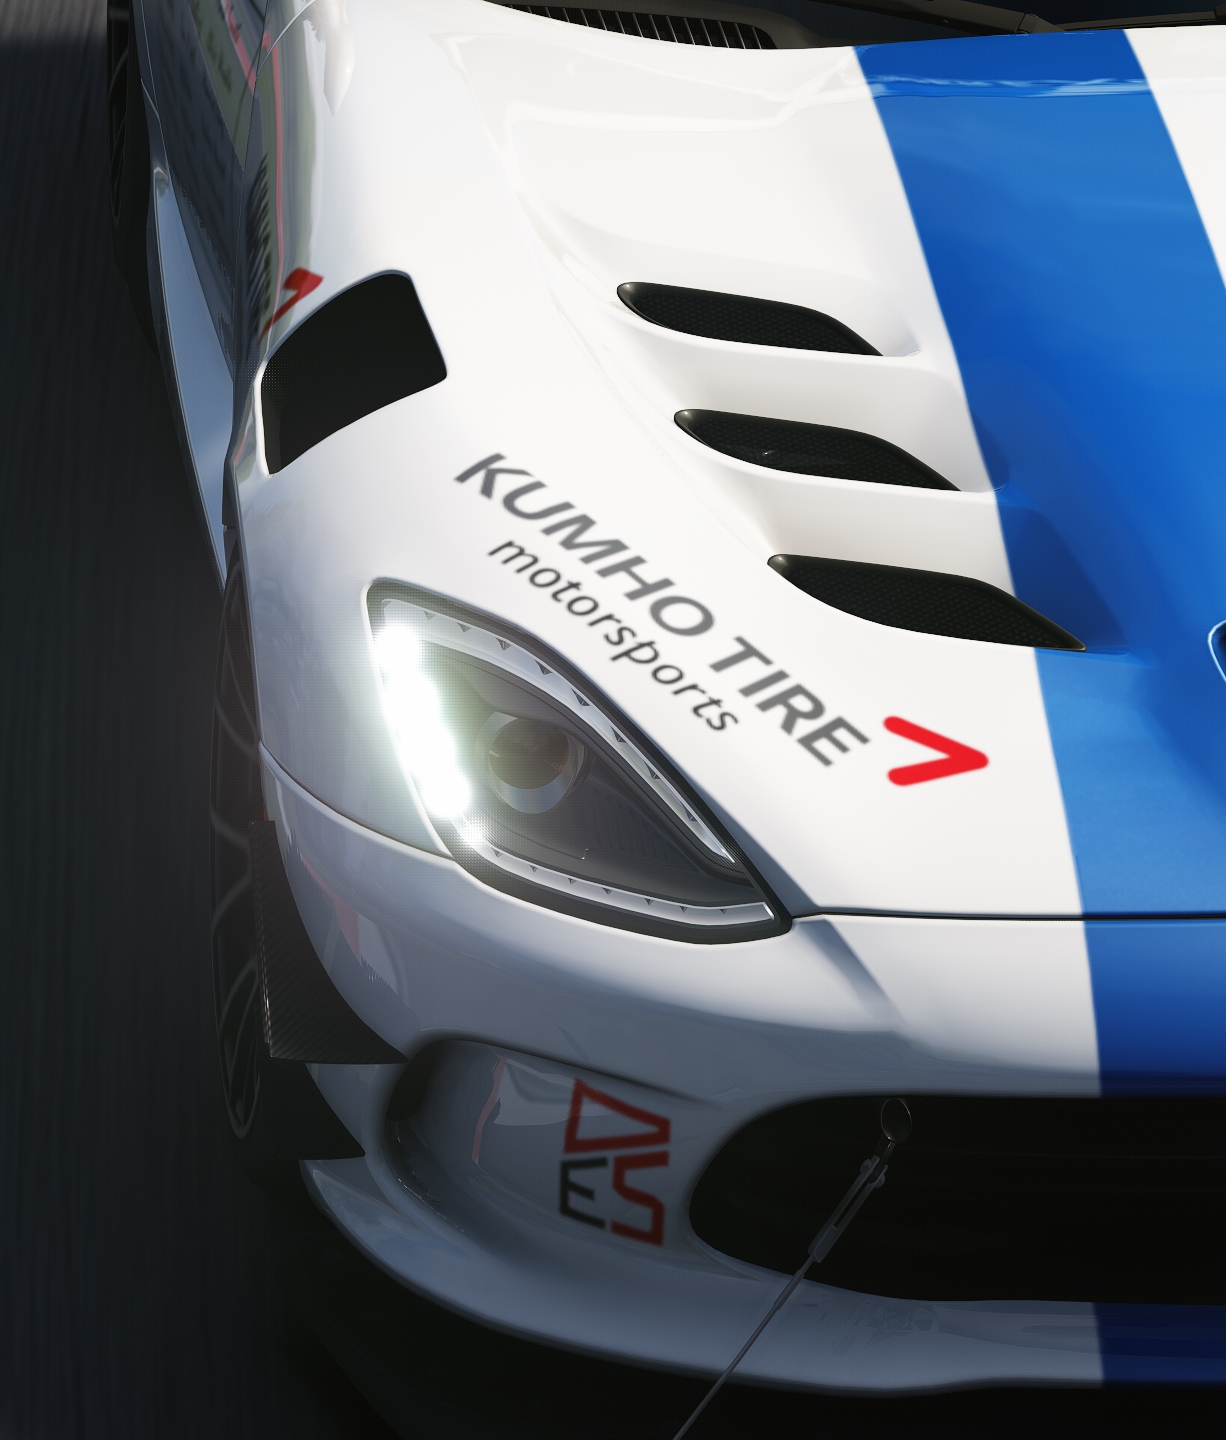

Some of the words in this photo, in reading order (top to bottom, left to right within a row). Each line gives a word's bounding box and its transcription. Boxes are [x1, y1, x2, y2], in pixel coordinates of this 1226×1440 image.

[454, 452, 715, 638] KUMHO
[709, 635, 871, 766] TIRE
[487, 537, 740, 733] motorsports
